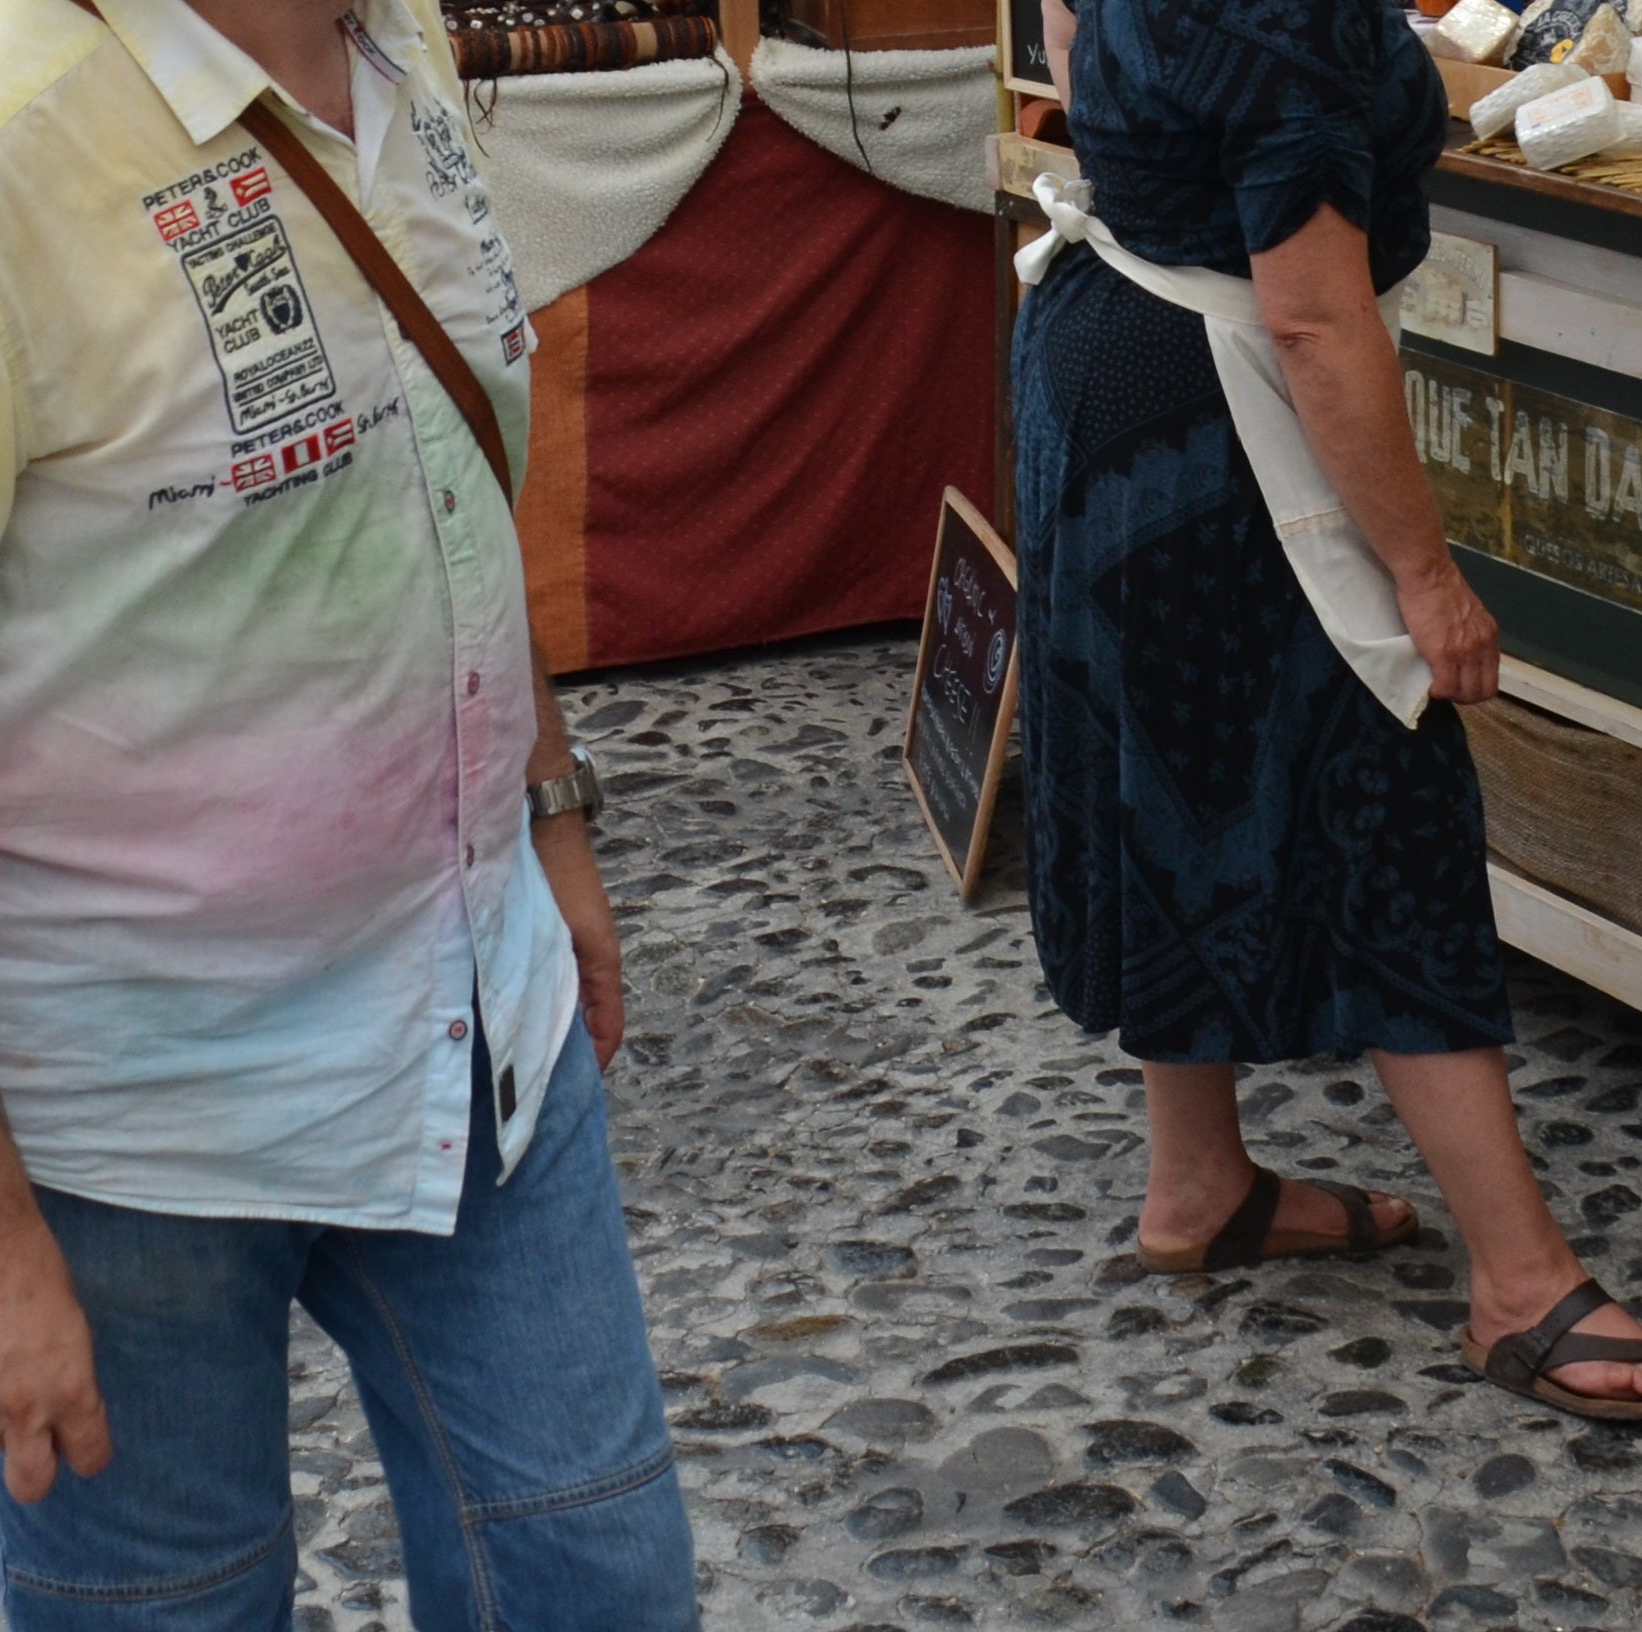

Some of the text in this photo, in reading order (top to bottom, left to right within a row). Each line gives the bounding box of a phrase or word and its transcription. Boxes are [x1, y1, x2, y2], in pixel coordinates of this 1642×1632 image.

[142, 146, 262, 211] PETER&COOK
[166, 197, 271, 253] YACHT CLUB
[214, 308, 261, 338] YACHT
[224, 328, 261, 354] CLUB
[231, 399, 345, 458] PETER&COOK
[1405, 370, 1471, 474] QUE
[1485, 396, 1568, 504] TAN
[243, 451, 353, 507] YACHTING CLUB
